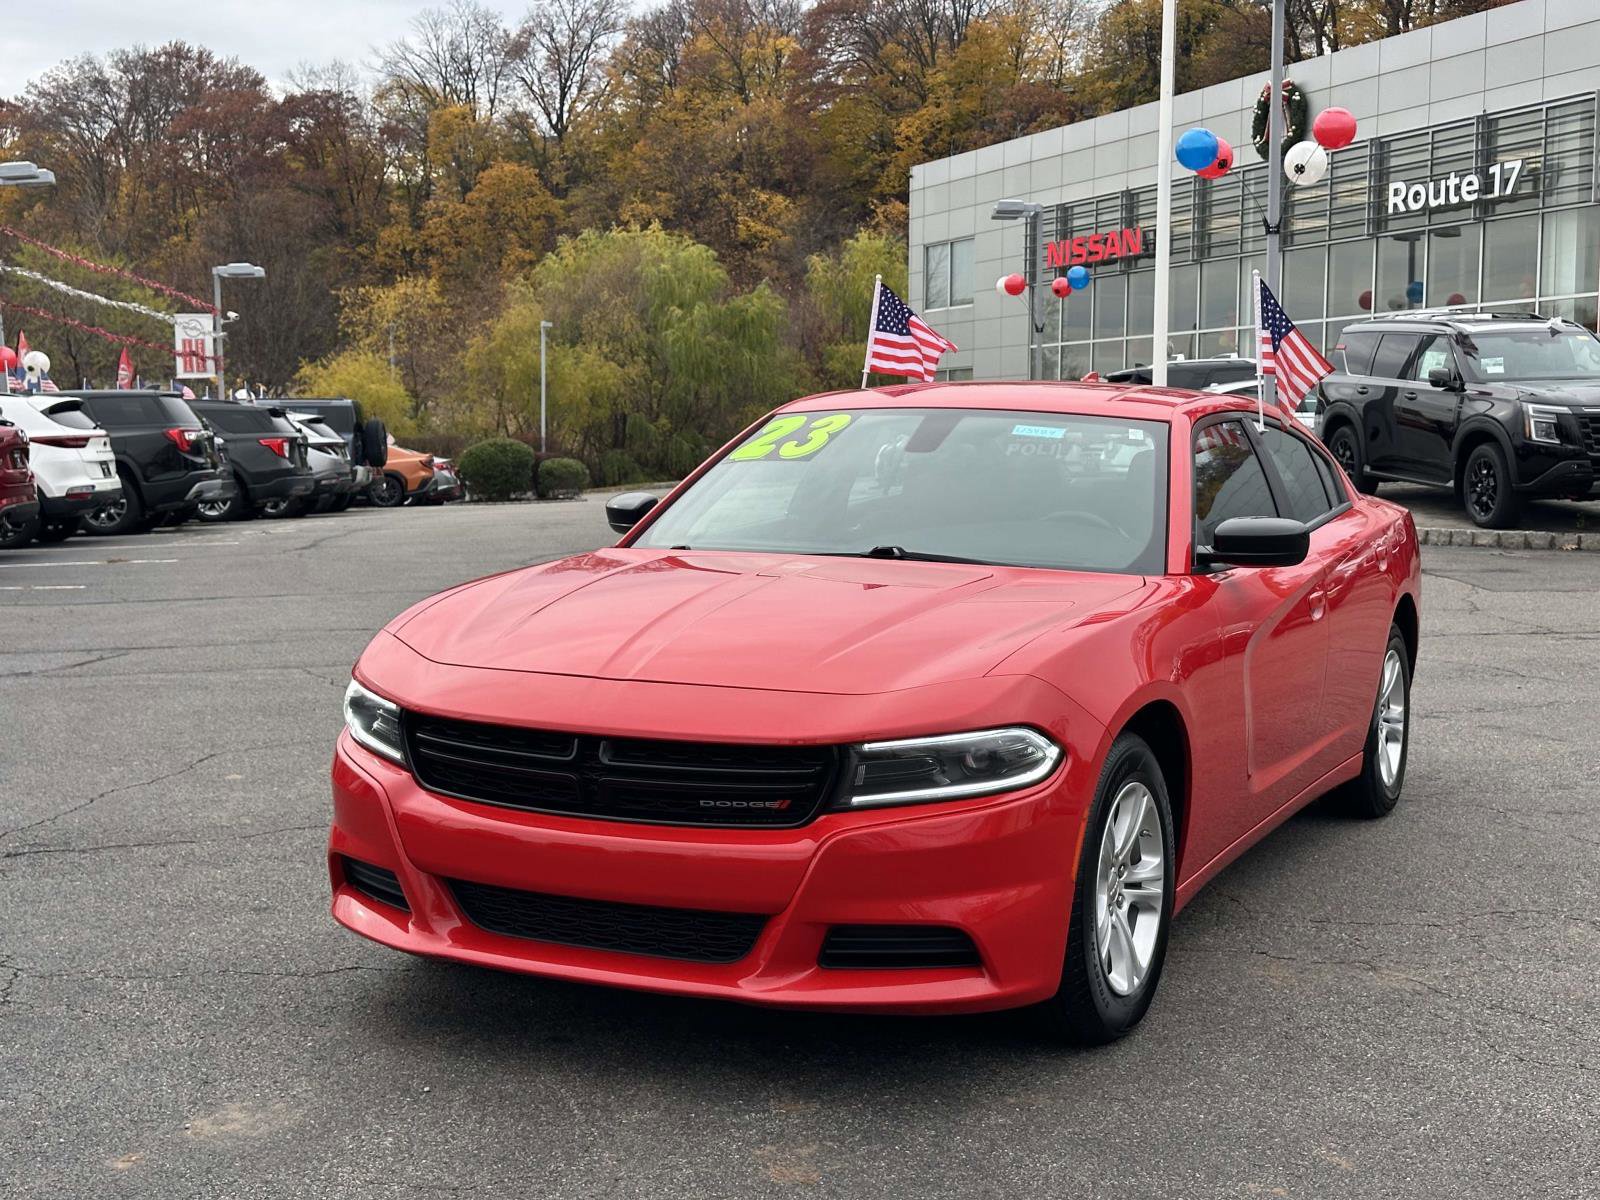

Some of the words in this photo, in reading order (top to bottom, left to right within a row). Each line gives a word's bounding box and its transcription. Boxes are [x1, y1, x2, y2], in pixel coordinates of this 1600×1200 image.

[1387, 171, 1480, 214] Route
[1488, 159, 1523, 197] 17
[1046, 223, 1142, 269] NISSAN
[729, 414, 852, 461] 23
[699, 800, 780, 808] DODGE
